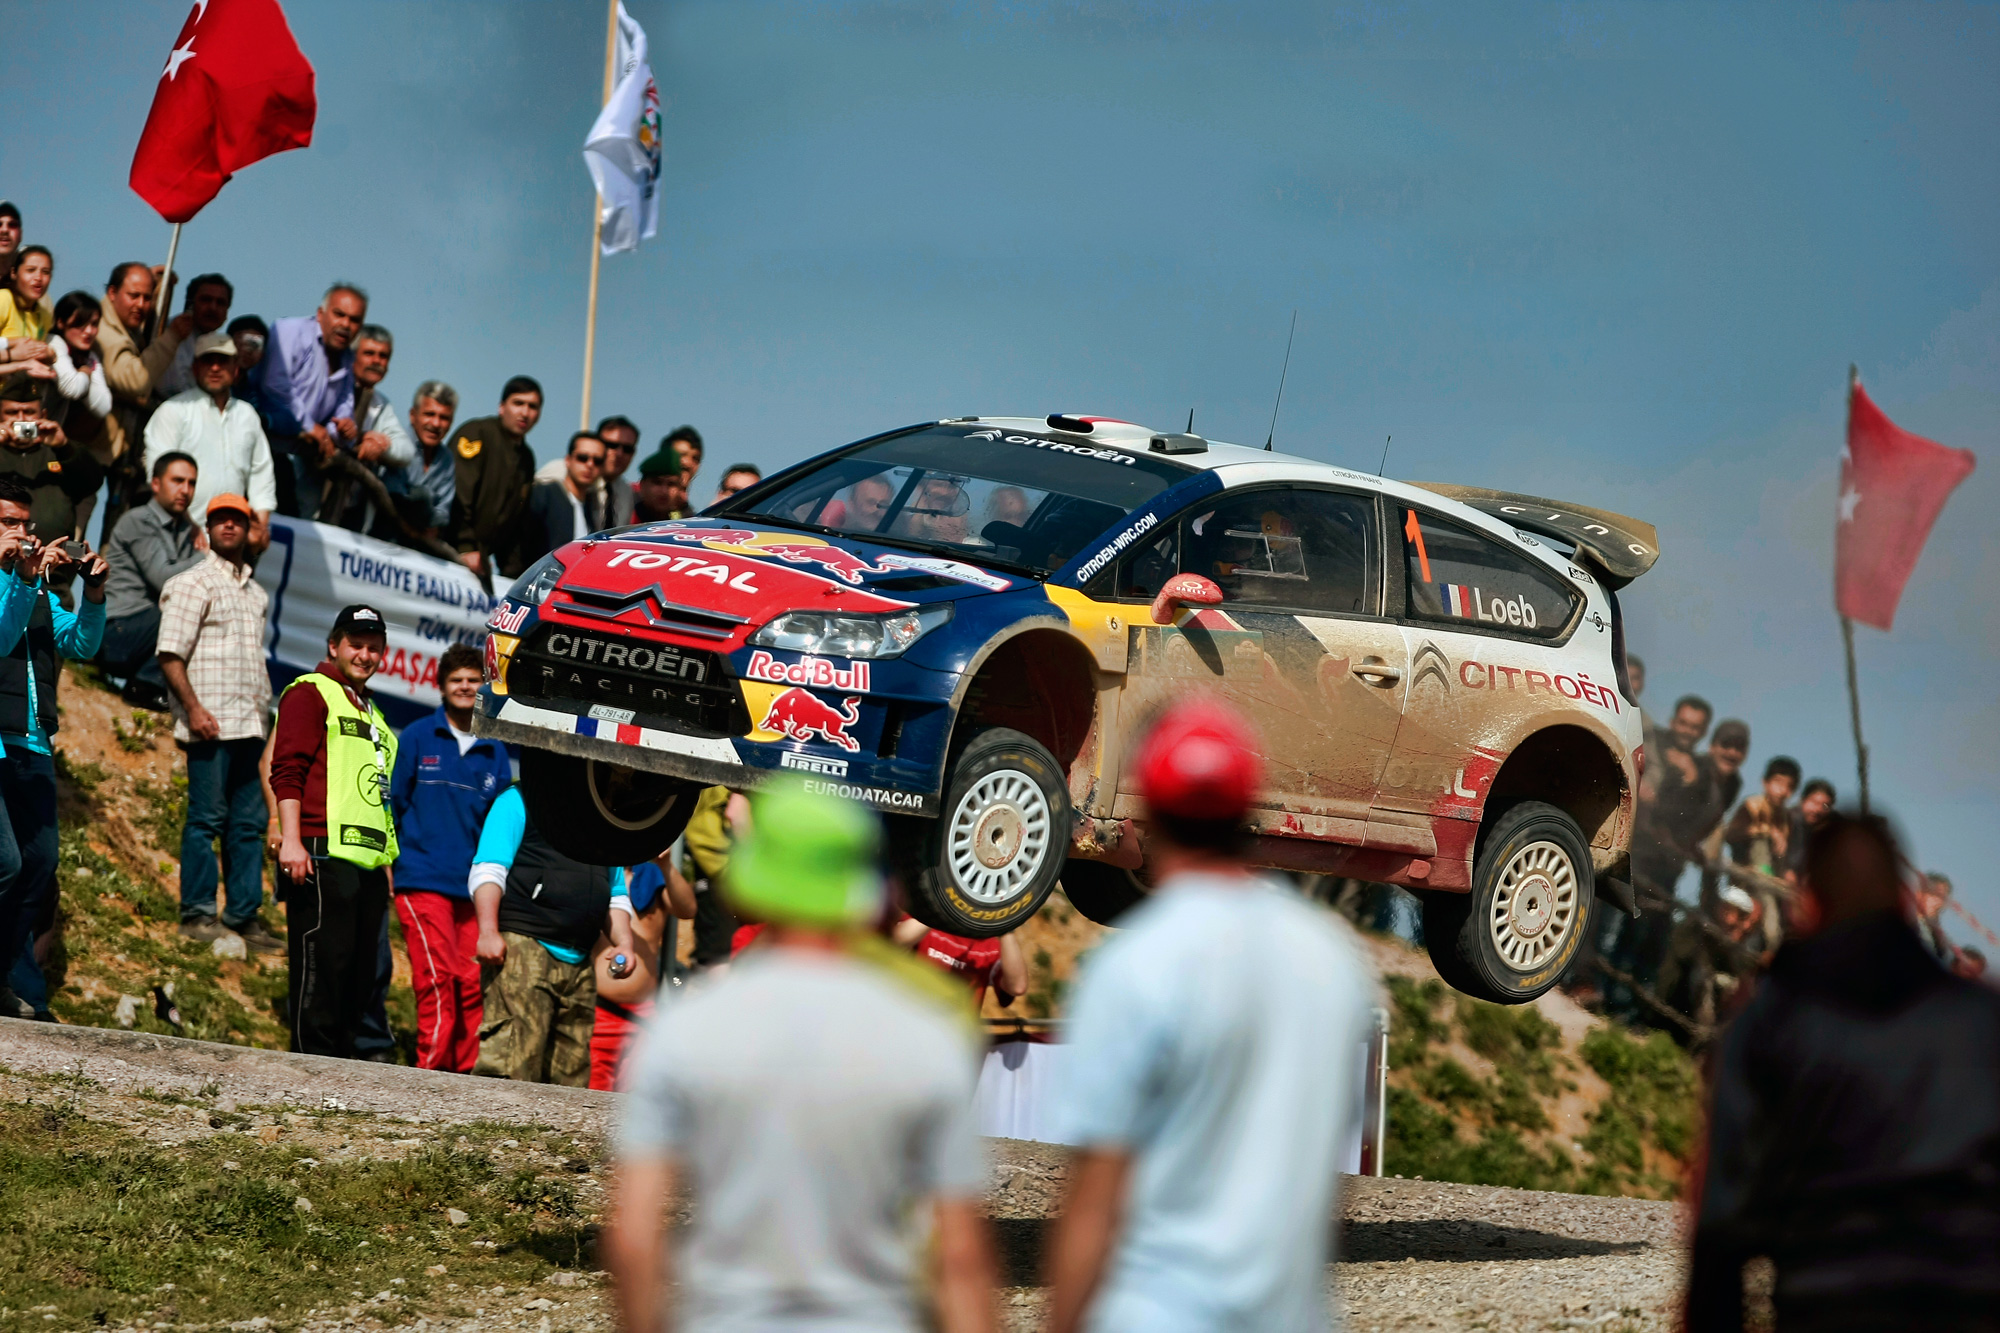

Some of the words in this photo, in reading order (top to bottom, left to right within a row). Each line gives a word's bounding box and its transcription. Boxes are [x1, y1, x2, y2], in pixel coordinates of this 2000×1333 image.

[1404, 509, 1432, 583] 1
[1500, 506, 1649, 556] CING
[339, 549, 412, 593] TÜRKİYE
[606, 549, 759, 595] TOTAL
[947, 570, 1001, 588] TURKEY
[1176, 586, 1208, 596] OAKLEY
[1473, 587, 1537, 629] Loeb
[547, 634, 706, 683] CITROËN
[747, 650, 811, 686] Red
[812, 659, 871, 692] Bull
[542, 665, 700, 705] RACING
[1459, 660, 1621, 715] CITROËN
[591, 706, 632, 721] AL-791-AR
[781, 751, 849, 778] PIRELLI
[803, 780, 924, 809] EURODATACAR
[945, 886, 1034, 921] SCORPION
[928, 947, 967, 970] SPORT
